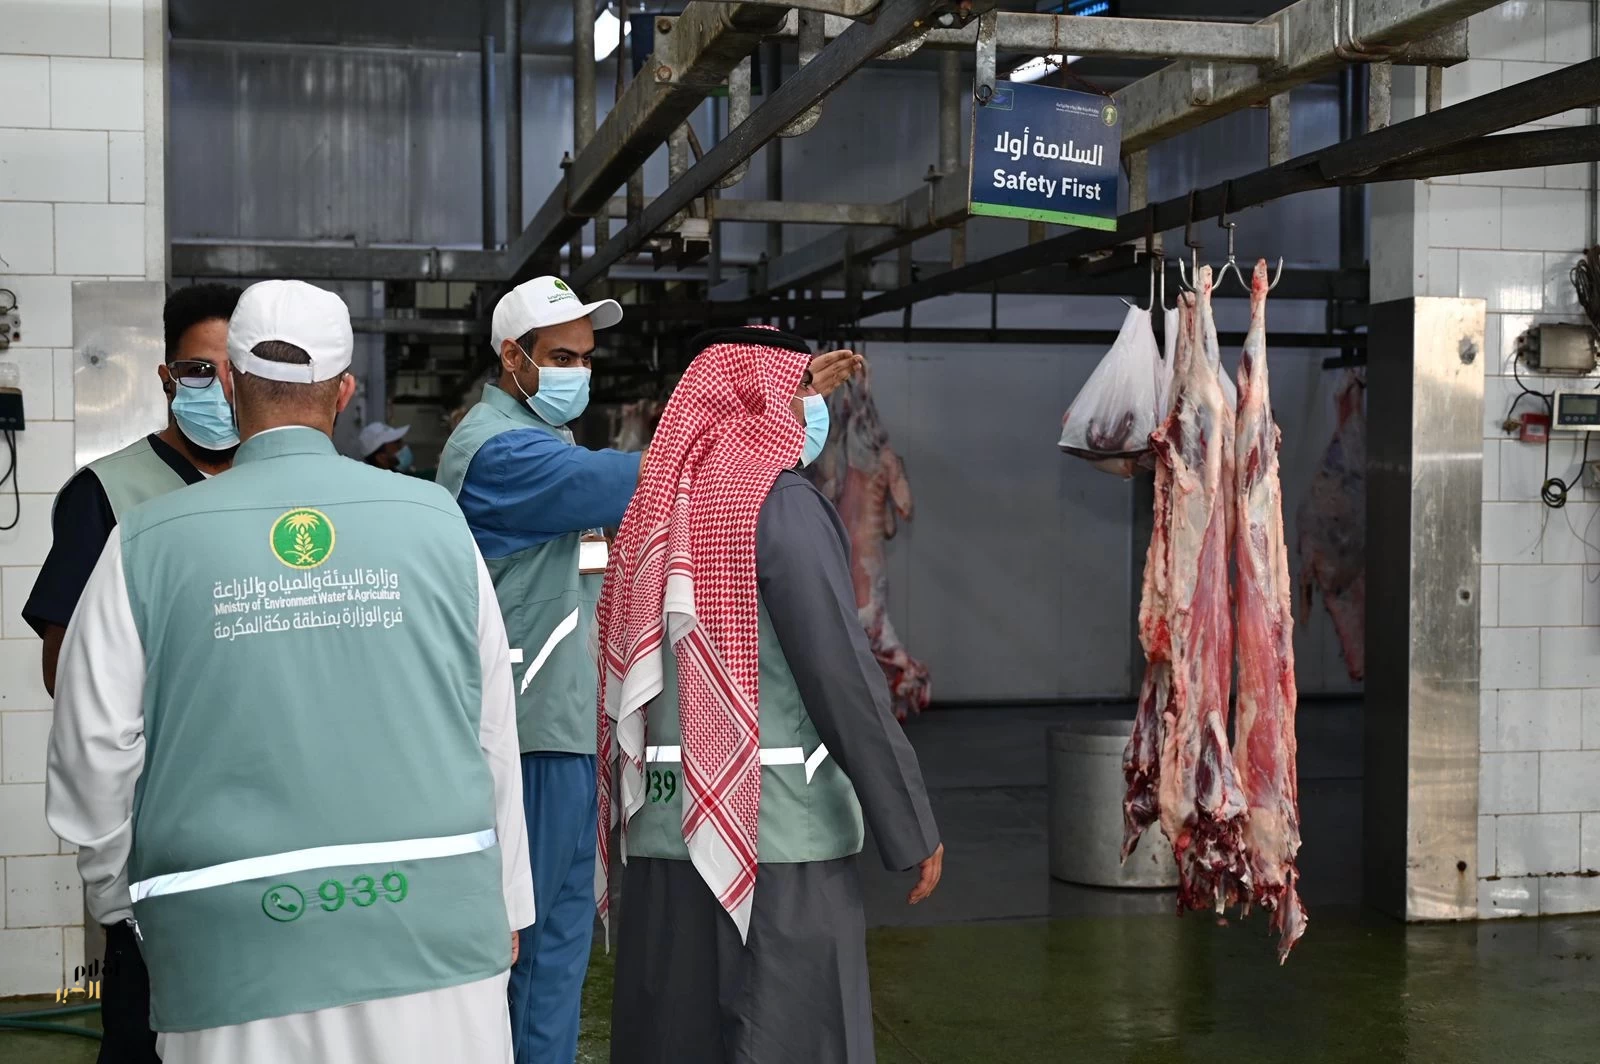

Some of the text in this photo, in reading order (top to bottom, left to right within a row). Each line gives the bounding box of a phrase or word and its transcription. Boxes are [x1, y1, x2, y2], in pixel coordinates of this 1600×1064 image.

[994, 126, 1103, 166] السلامة أولا
[993, 168, 1101, 200] Safety First
[213, 568, 398, 600] وزارة البيئة والمياه والزراعة
[214, 588, 400, 616] Ministry of Environment Water & Agriculture
[214, 605, 403, 641] فرع الوزارة بمنطقة مكة المكرمة
[318, 870, 409, 912] 939
